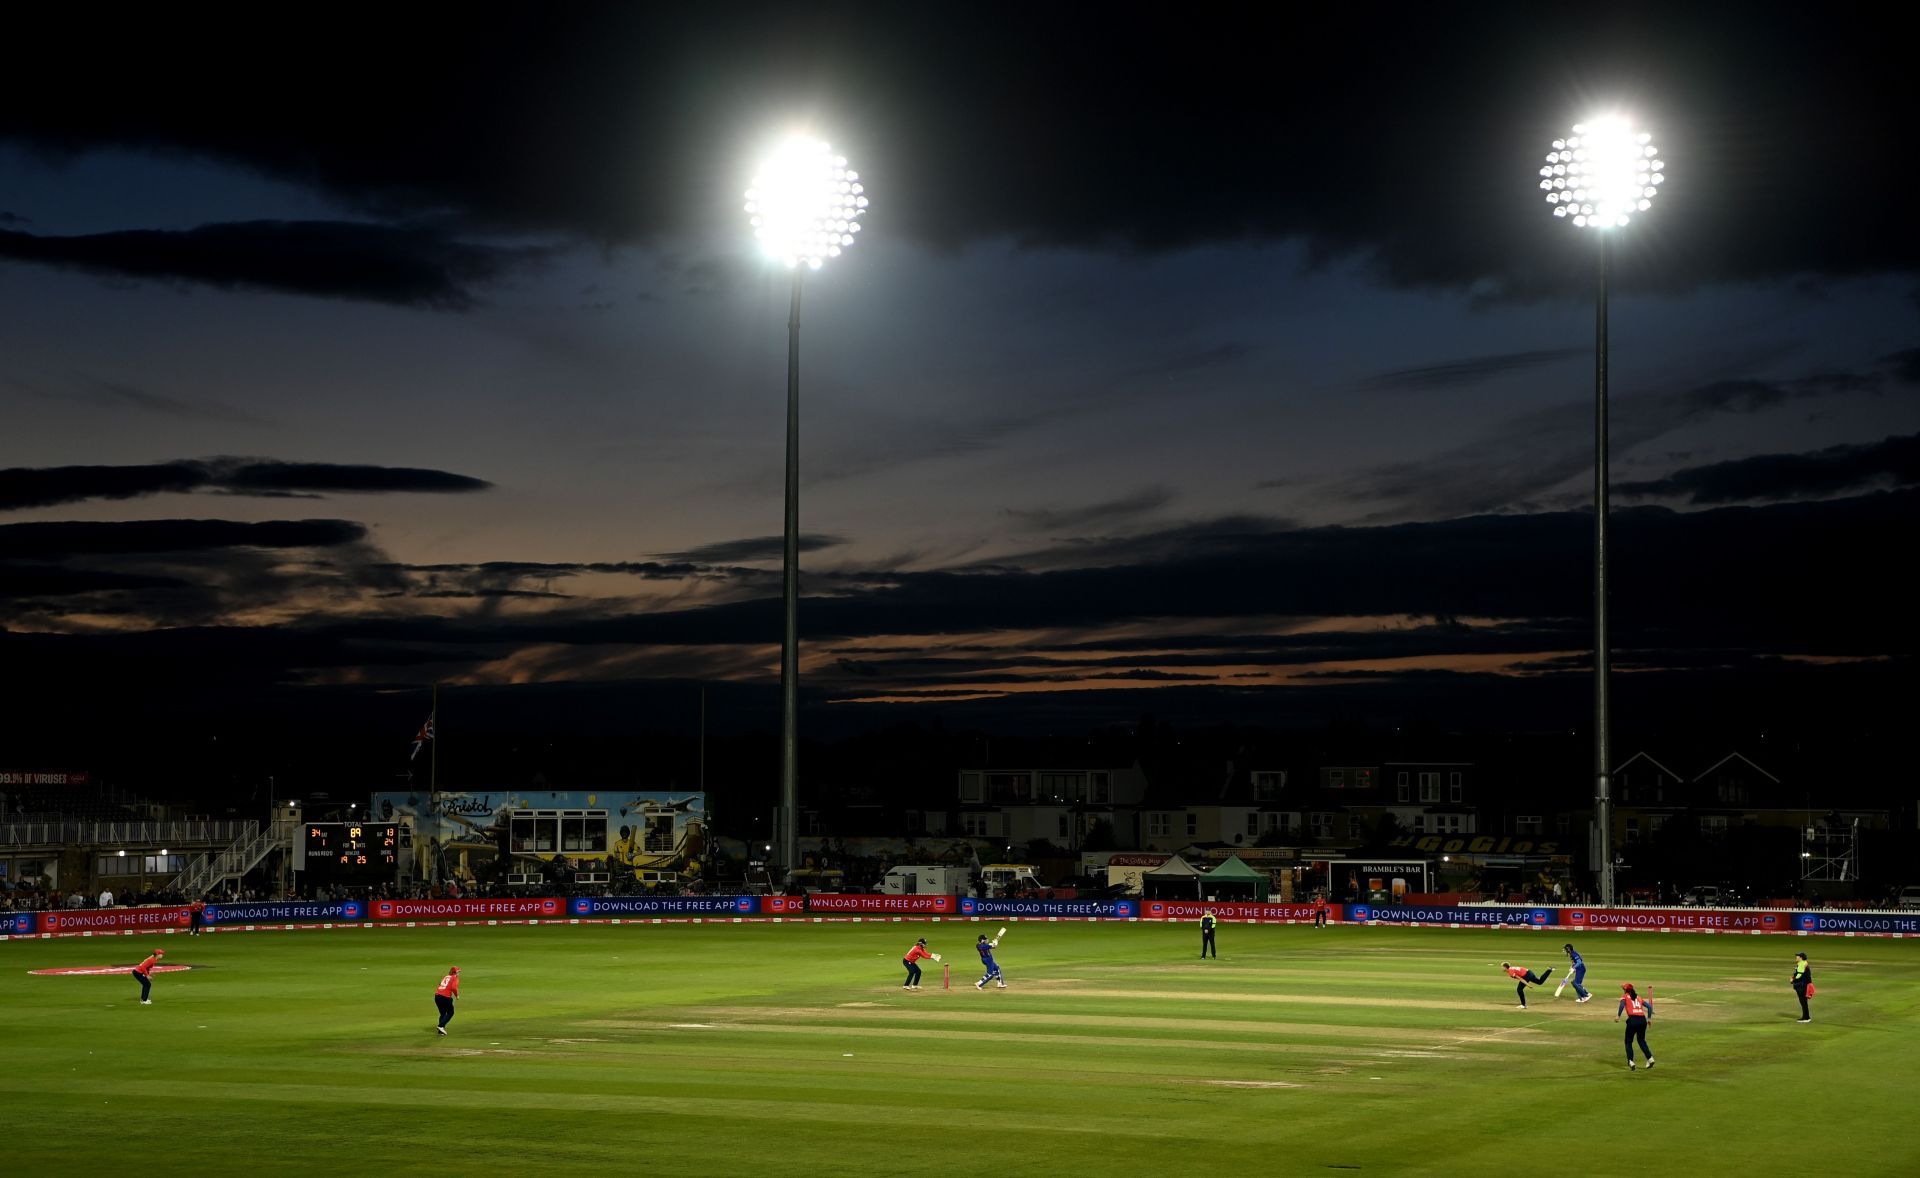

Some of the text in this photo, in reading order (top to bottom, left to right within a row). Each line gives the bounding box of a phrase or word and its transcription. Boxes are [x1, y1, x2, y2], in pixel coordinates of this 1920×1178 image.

[24, 773, 32, 784] OF
[33, 773, 67, 784] VIRUSES
[443, 795, 493, 817] Bristol
[311, 828, 321, 837] 34
[350, 827, 362, 838] 89
[387, 828, 394, 837] 13
[350, 840, 356, 850] 7
[384, 838, 394, 846] 24
[1388, 835, 1561, 853] #GoGlos
[356, 855, 367, 864] 25
[1362, 865, 1404, 873] BRAMBLE'S
[396, 903, 541, 915] DOWNLOAD THE FREE APP
[593, 901, 736, 911] DOWNLOAD THE FREE APP
[861, 899, 881, 908] THE
[884, 899, 909, 908] FREE
[912, 899, 932, 908] APP
[977, 903, 1115, 914] DOWNLOAD THE FREE APP
[217, 908, 269, 919] DOWNLOAD
[272, 907, 290, 918] THE
[293, 906, 318, 917] FREE
[322, 906, 342, 916] APP
[1238, 907, 1259, 917] THE
[1264, 908, 1290, 917] FREE
[1294, 908, 1315, 918] APP
[1372, 909, 1530, 922] DOWNLOAD THE FREE APP
[60, 914, 117, 928] DOWNLOAD
[118, 914, 136, 924] THE
[139, 913, 160, 923] FREE
[162, 912, 179, 923] APP
[1590, 914, 1759, 926] DOWNLOAD THE FREE APP
[1819, 918, 1917, 930] DOWNLOAD THE
[1631, 999, 1642, 1009] 14
